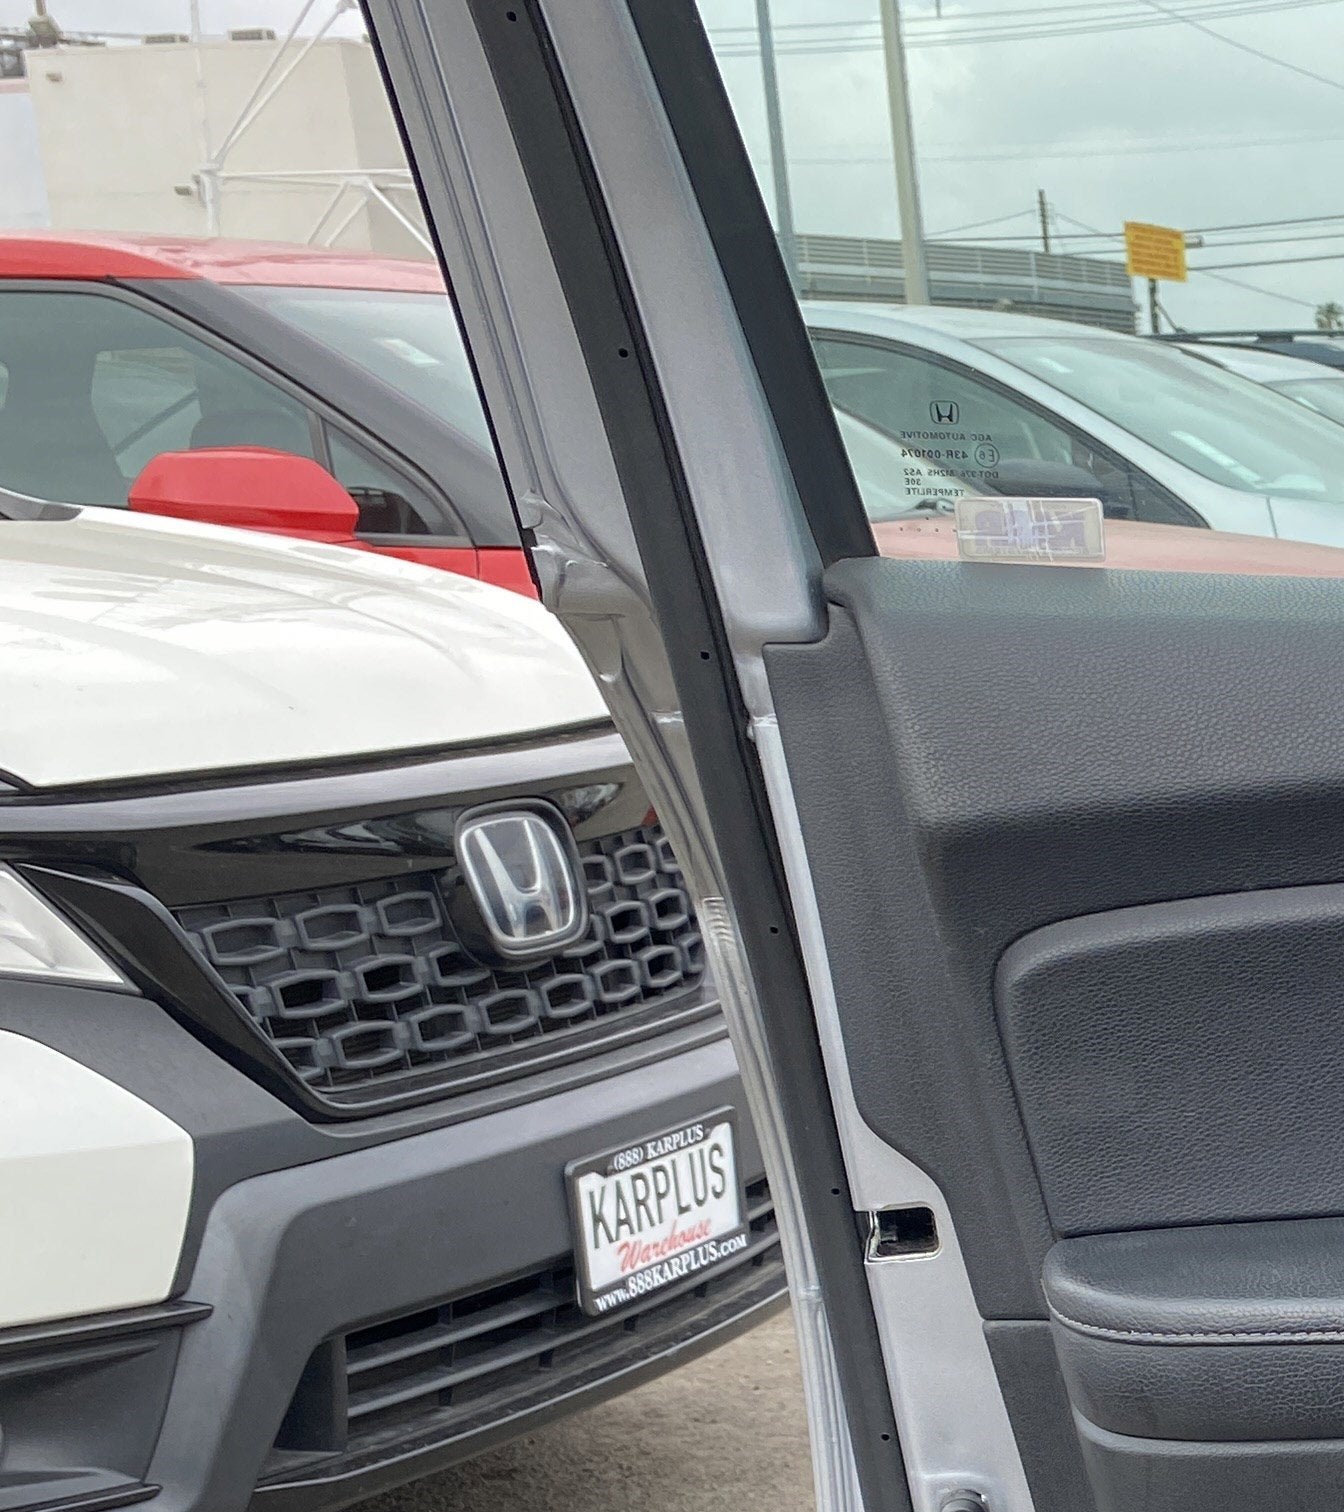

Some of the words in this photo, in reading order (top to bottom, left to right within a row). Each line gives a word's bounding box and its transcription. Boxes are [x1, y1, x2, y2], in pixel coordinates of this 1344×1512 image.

[613, 1147, 644, 1172] (888)
[646, 1123, 704, 1160] KARPLUS
[588, 1142, 727, 1249] KARPLUS
[615, 1217, 713, 1273] Warehouse
